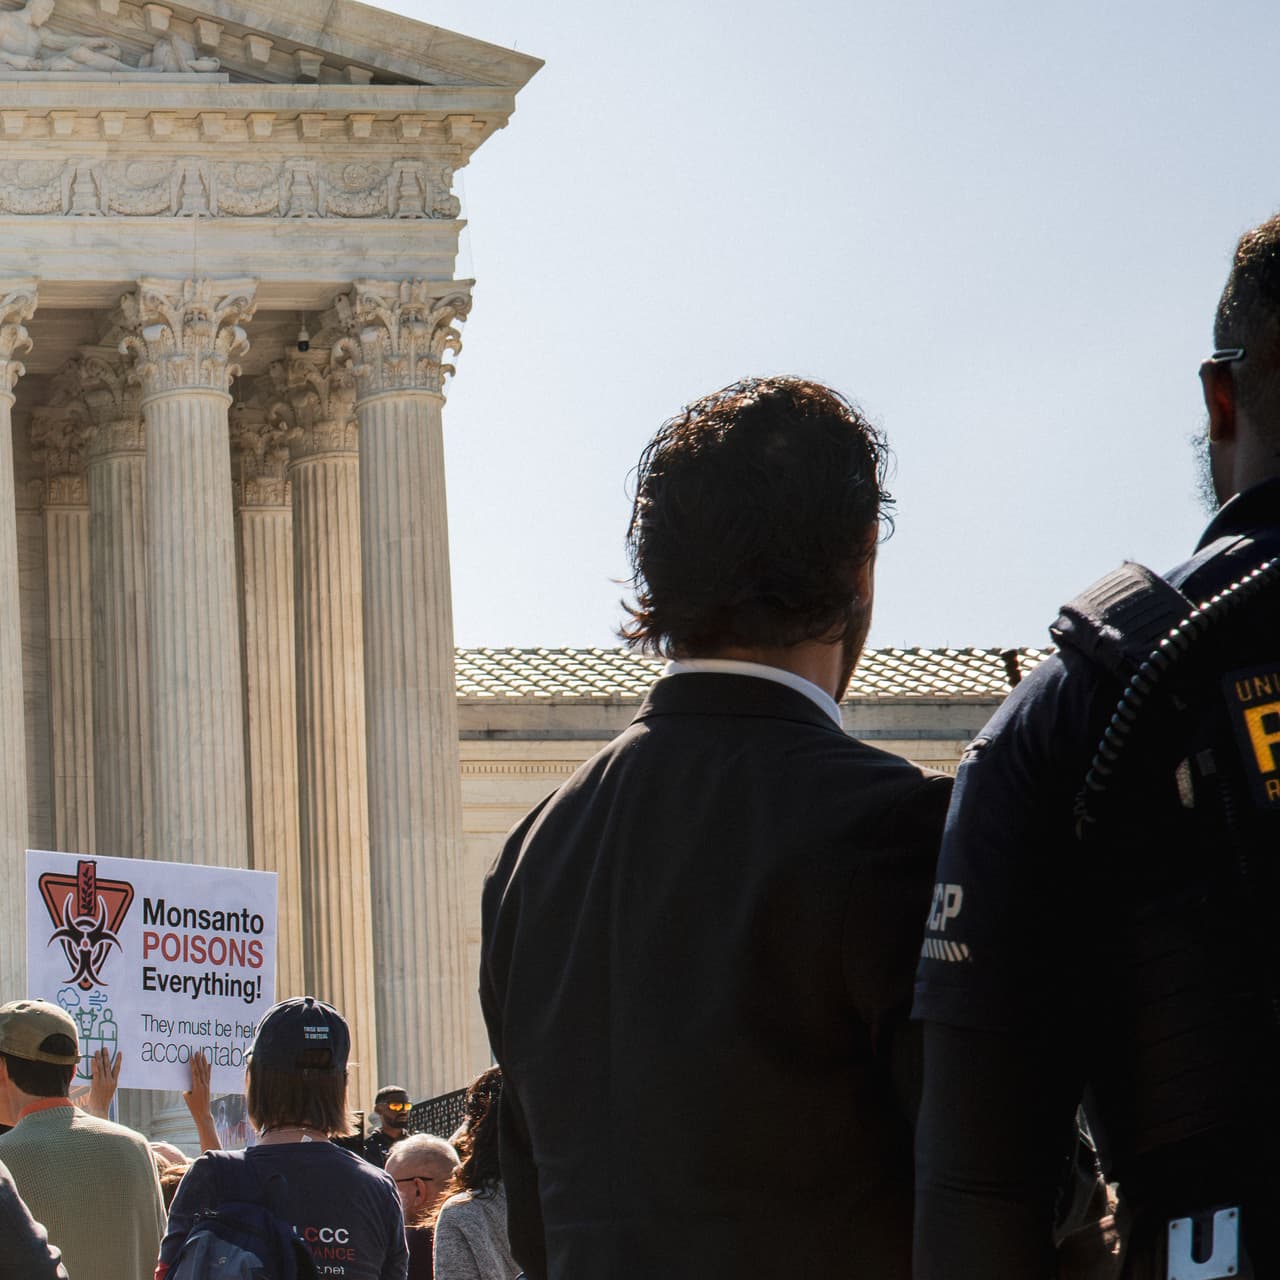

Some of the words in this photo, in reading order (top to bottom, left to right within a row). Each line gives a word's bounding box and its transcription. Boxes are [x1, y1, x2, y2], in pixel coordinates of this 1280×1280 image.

[143, 898, 264, 934] Monsanto
[143, 932, 264, 968] POISONS
[143, 966, 262, 1004] Everything!
[141, 1013, 175, 1038] They
[178, 1020, 211, 1036] must
[215, 1019, 232, 1037] be
[141, 1041, 247, 1067] accontabl
[311, 1246, 356, 1261] ANCE
